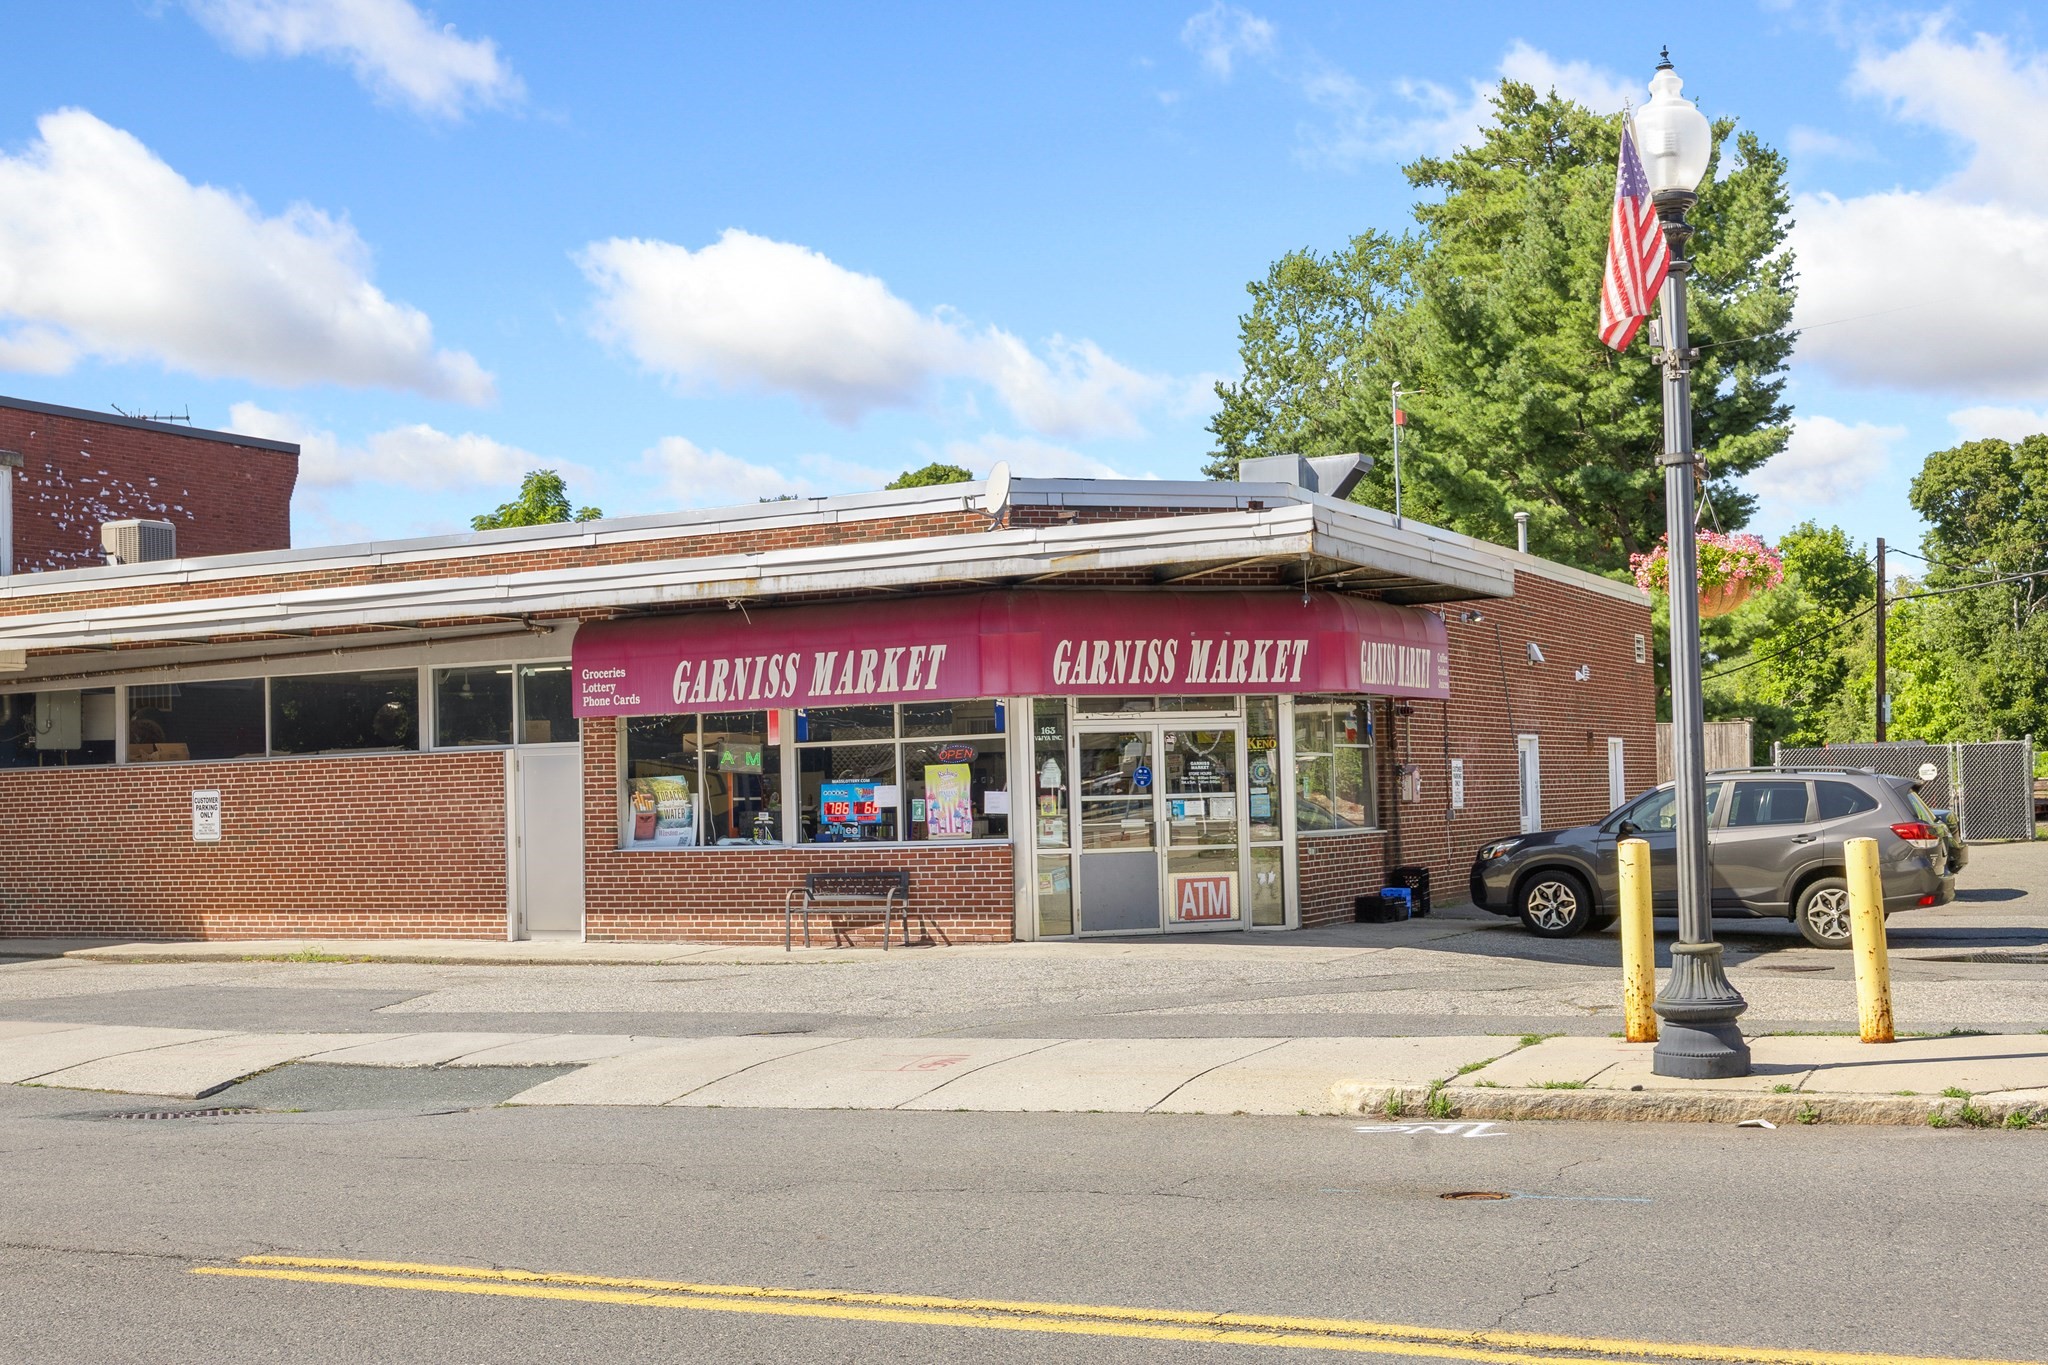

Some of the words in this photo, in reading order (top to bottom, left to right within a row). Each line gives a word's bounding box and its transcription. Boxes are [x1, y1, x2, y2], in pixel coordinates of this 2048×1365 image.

[1053, 638, 1178, 685] GARNISS
[1184, 639, 1309, 684] MARKET
[1361, 640, 1396, 686] GARNISS
[1398, 645, 1431, 689] MARKET
[582, 667, 626, 680] Groceries
[672, 652, 801, 705] GARNISS
[808, 644, 947, 697] MARKET
[582, 682, 616, 695] Lottery
[583, 696, 611, 707] Phone
[613, 694, 641, 705] Cards
[1041, 726, 1056, 735] 163
[939, 749, 974, 760] OPEN
[656, 790, 687, 801] TOBACCO
[200, 811, 213, 819] ONLY
[664, 807, 686, 820] WATER
[828, 802, 850, 815] 786
[1180, 881, 1228, 917] ATM
